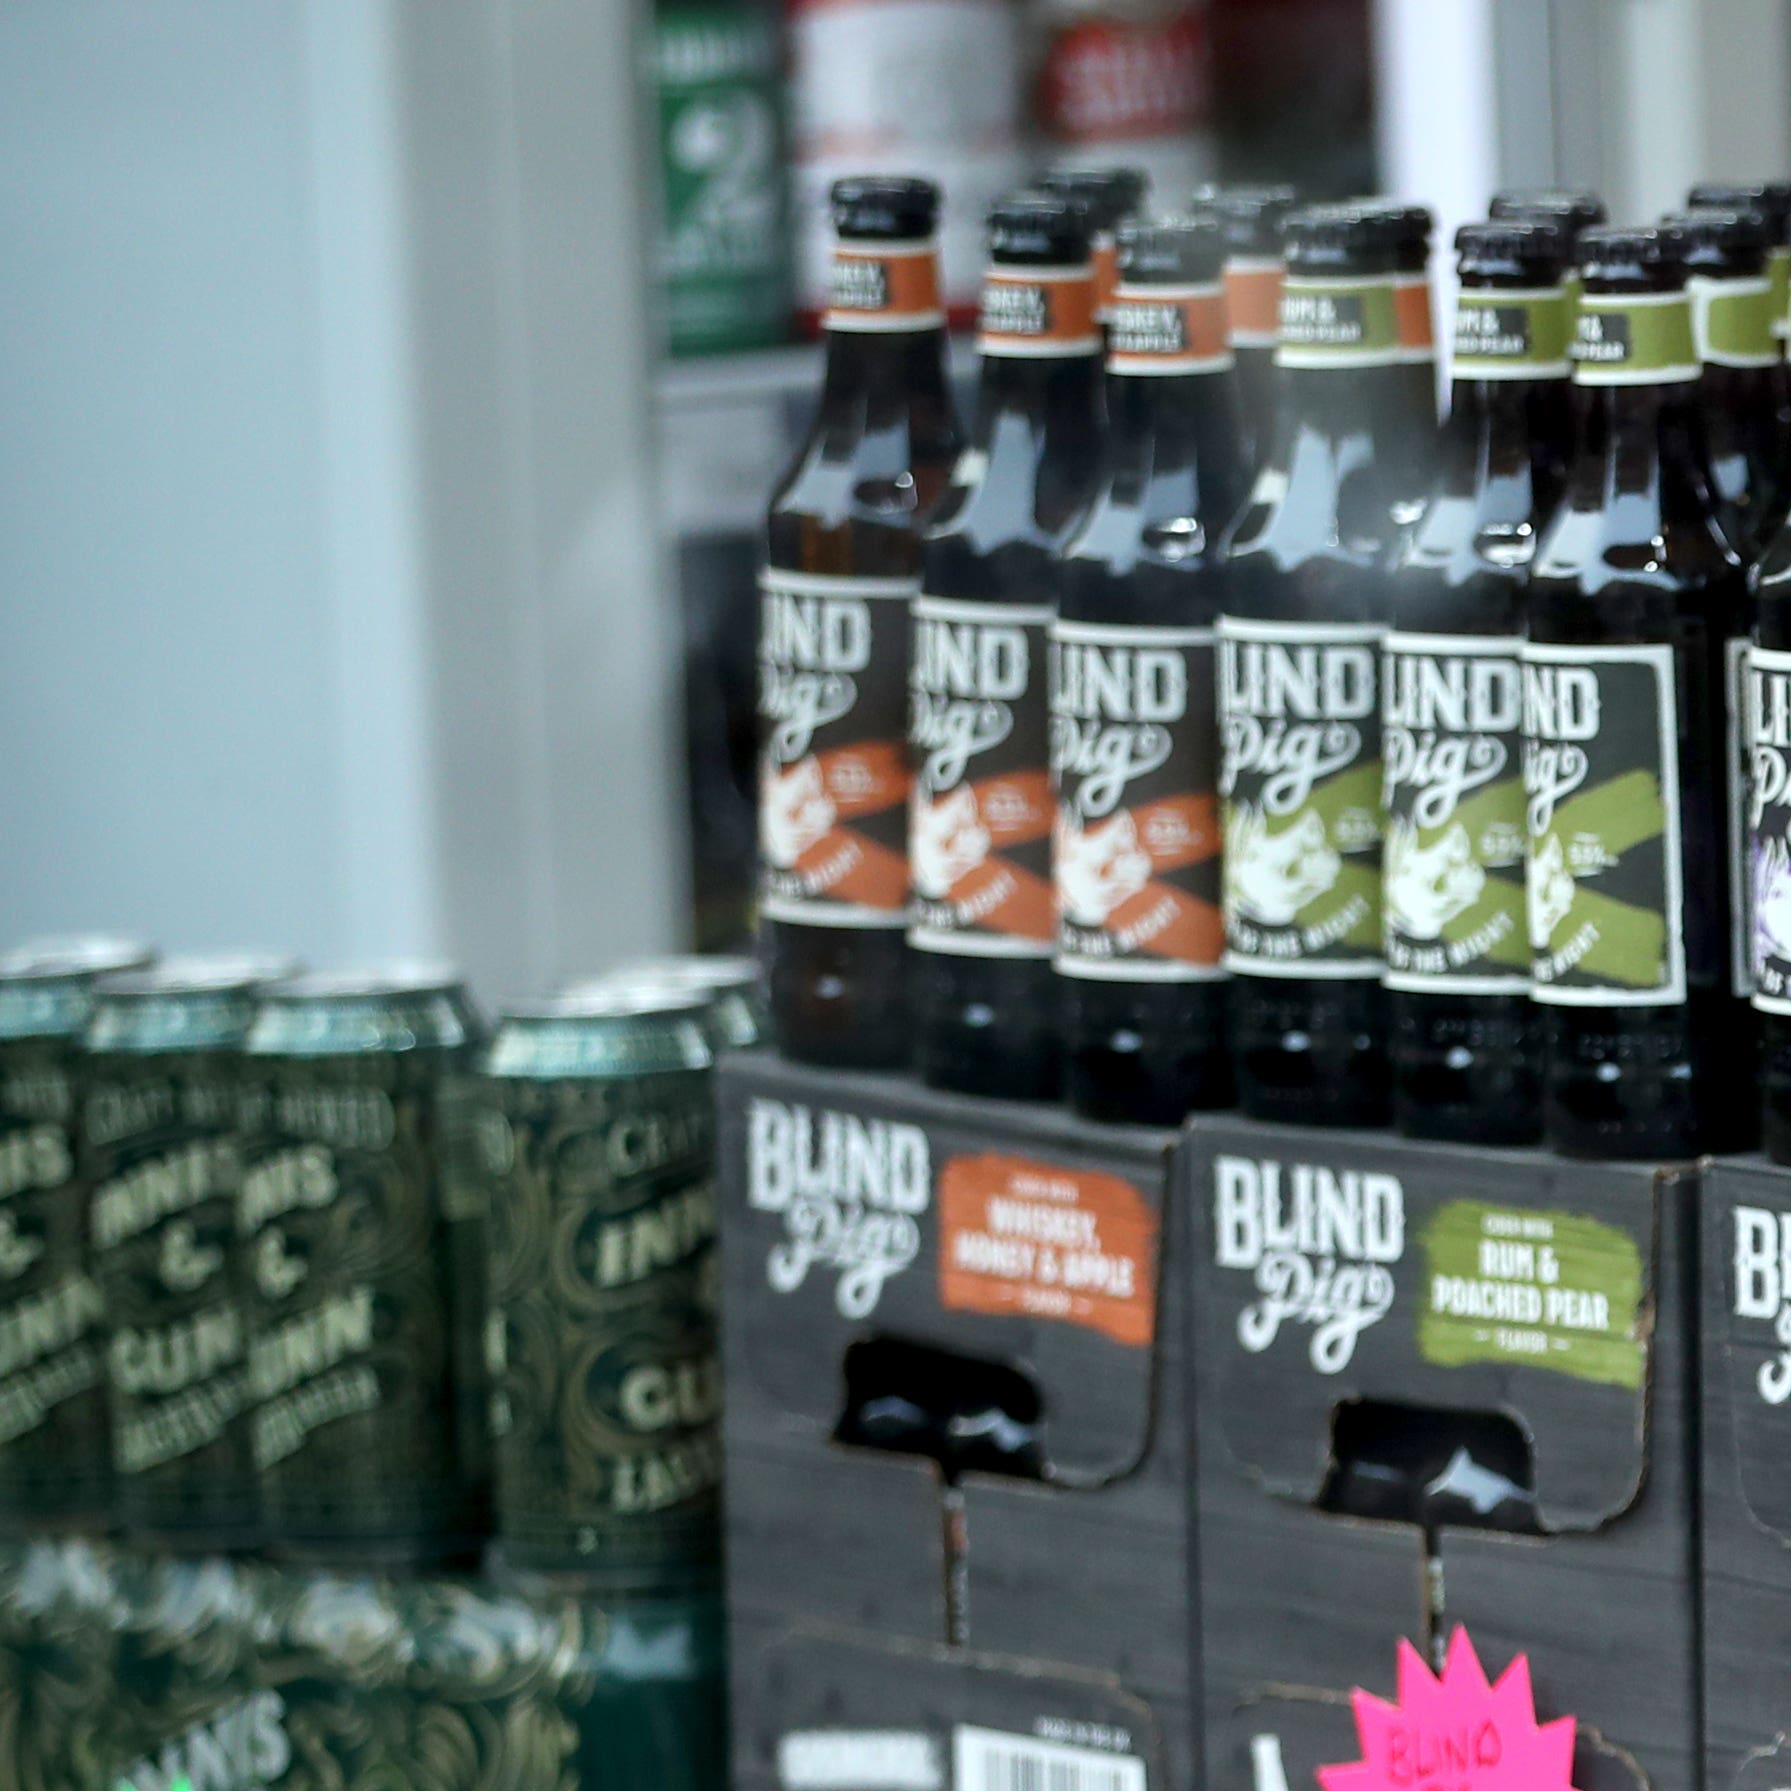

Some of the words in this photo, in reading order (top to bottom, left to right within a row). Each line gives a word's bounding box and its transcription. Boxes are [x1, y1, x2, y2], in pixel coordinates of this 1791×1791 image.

[747, 1098, 932, 1216] BLIND
[1212, 1154, 1406, 1270] BLIND
[765, 1195, 922, 1320] Pig
[1237, 1249, 1396, 1375] Pig
[1431, 1276, 1543, 1325] POACHED
[1546, 1288, 1610, 1331] PEAR
[1479, 1239, 1534, 1280] RUM
[1537, 1246, 1560, 1284] &
[1388, 1721, 1501, 1786] BLIND
